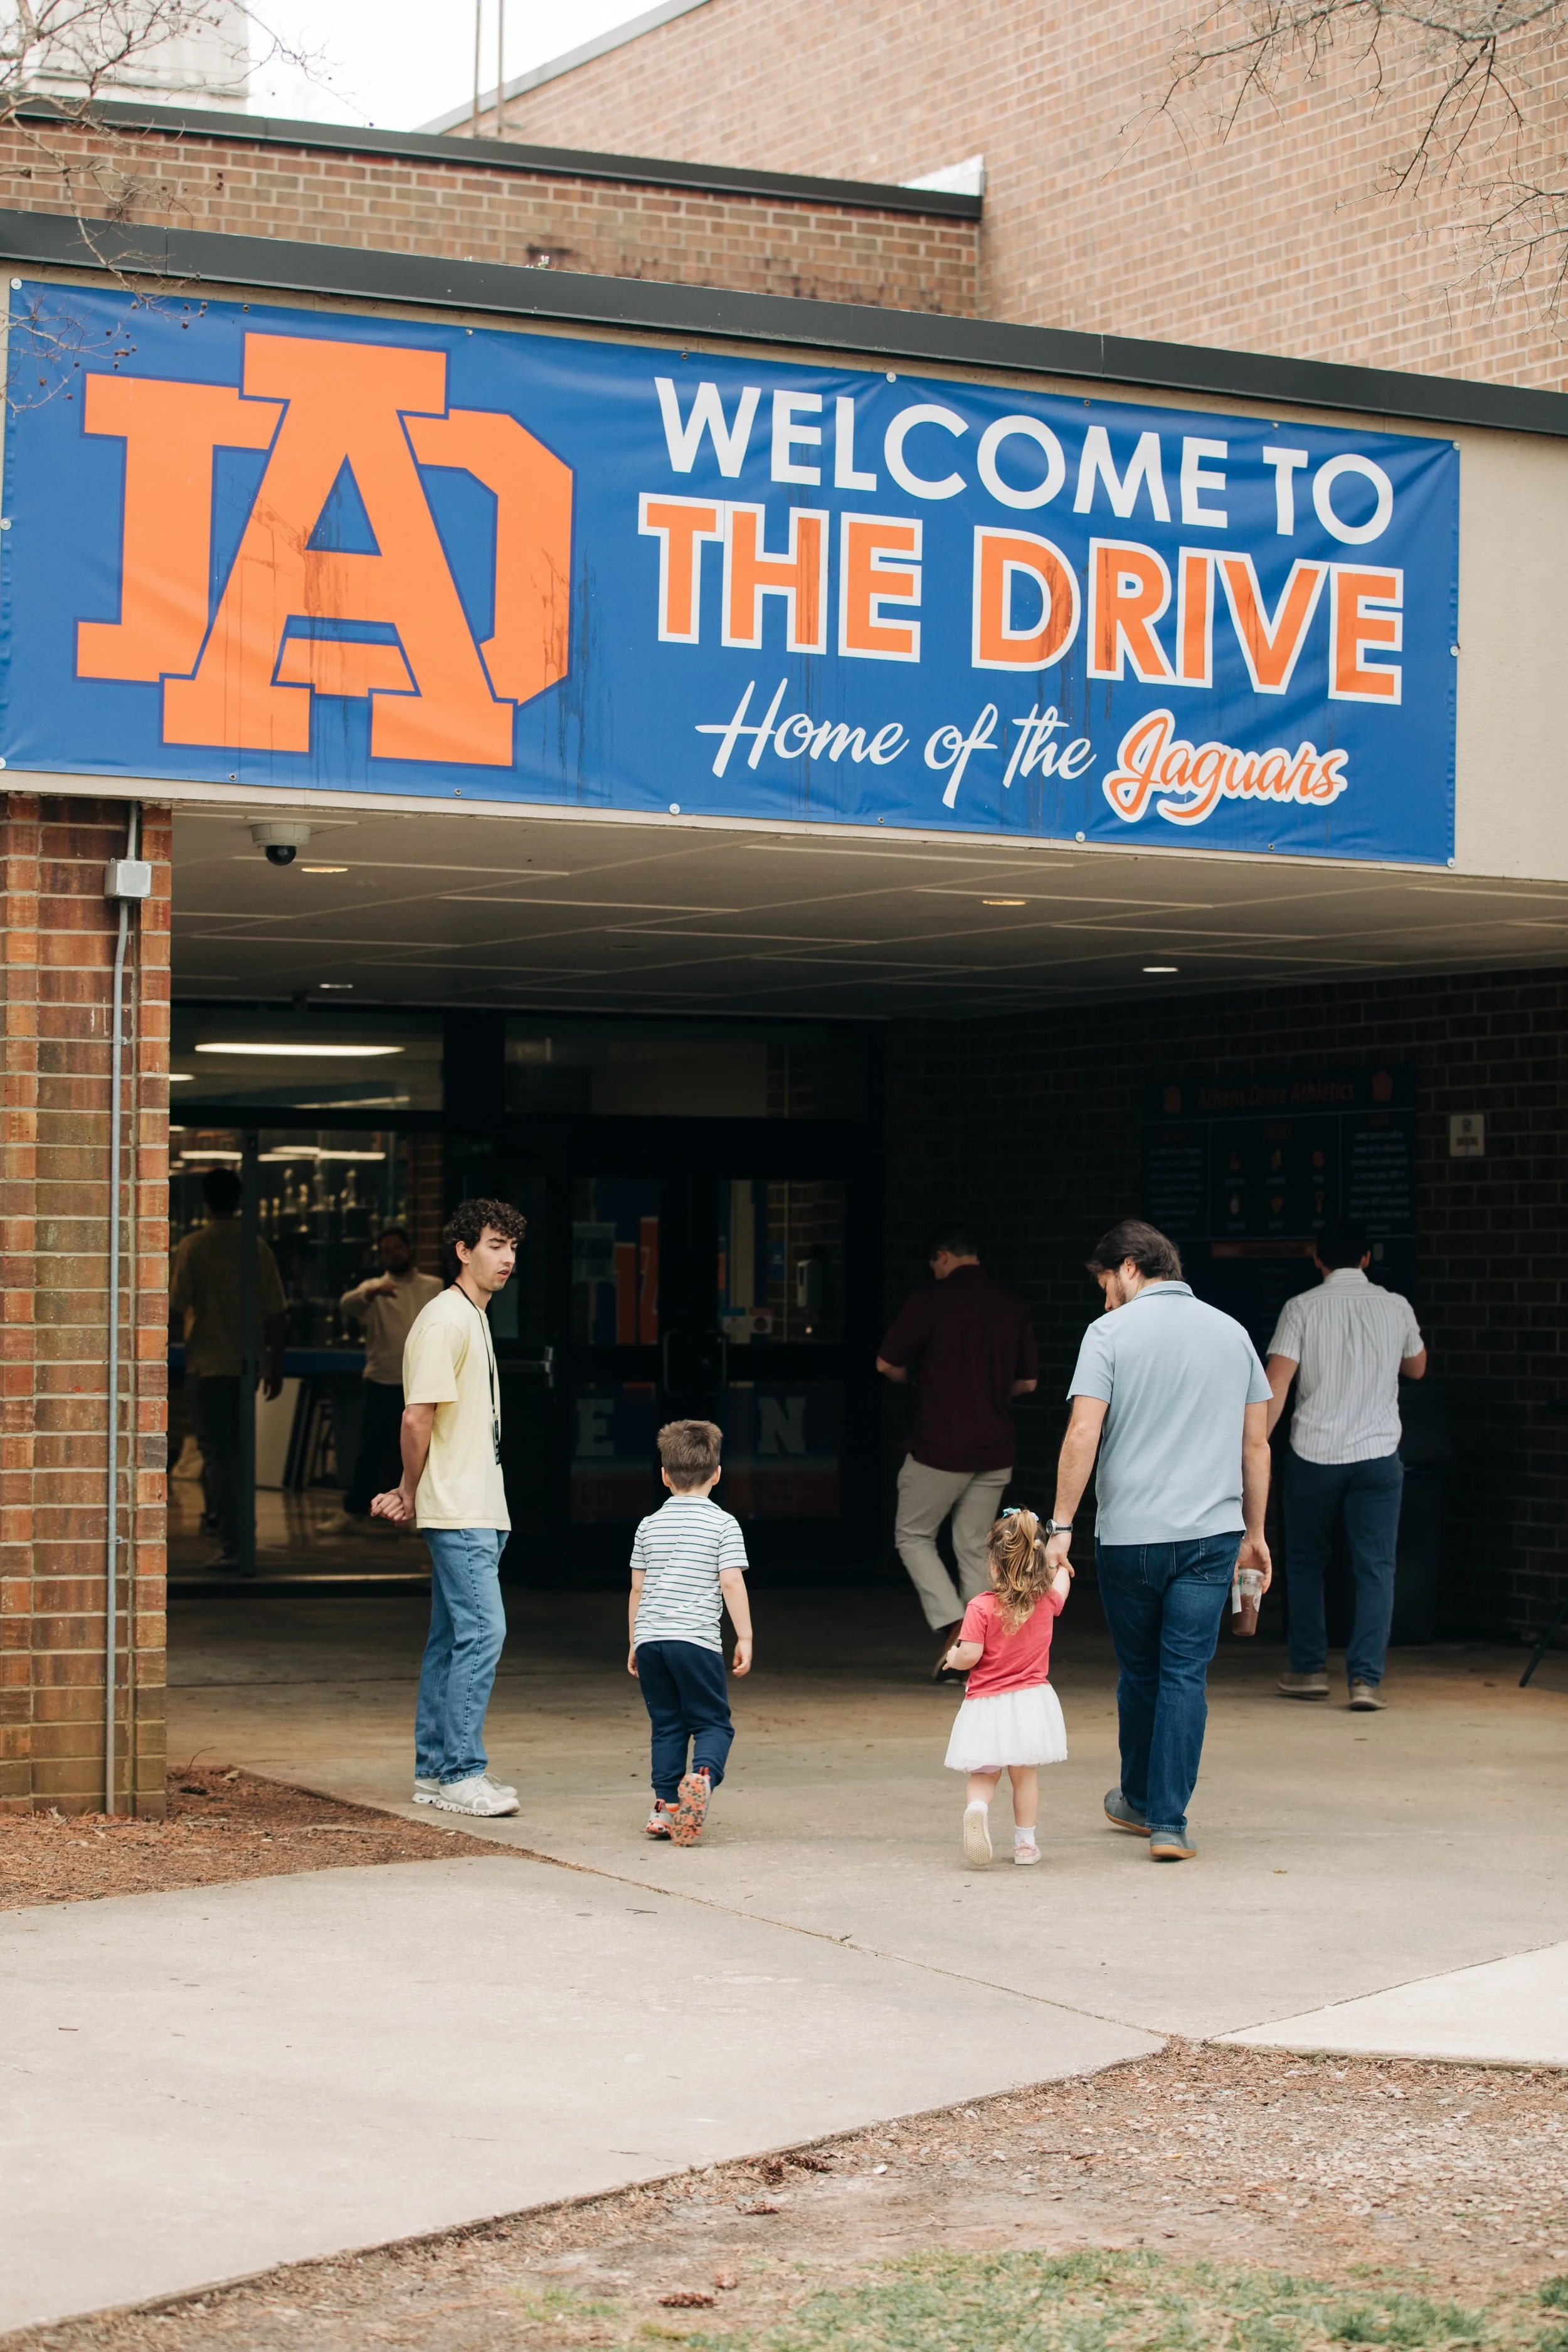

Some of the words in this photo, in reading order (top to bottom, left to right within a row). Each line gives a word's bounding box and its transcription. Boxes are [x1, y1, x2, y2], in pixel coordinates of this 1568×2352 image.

[654, 377, 1228, 528] WELCOME
[1263, 446, 1394, 544] TO
[638, 492, 923, 663] THE
[972, 525, 1404, 705] DRIVE
[695, 677, 909, 778] Home
[924, 702, 998, 809] of
[1004, 703, 1096, 788] the
[1103, 708, 1348, 827] Jaguars
[1197, 1086, 1246, 1109] Athens
[1249, 1084, 1288, 1106] Drive
[1290, 1078, 1355, 1104] Athletics
